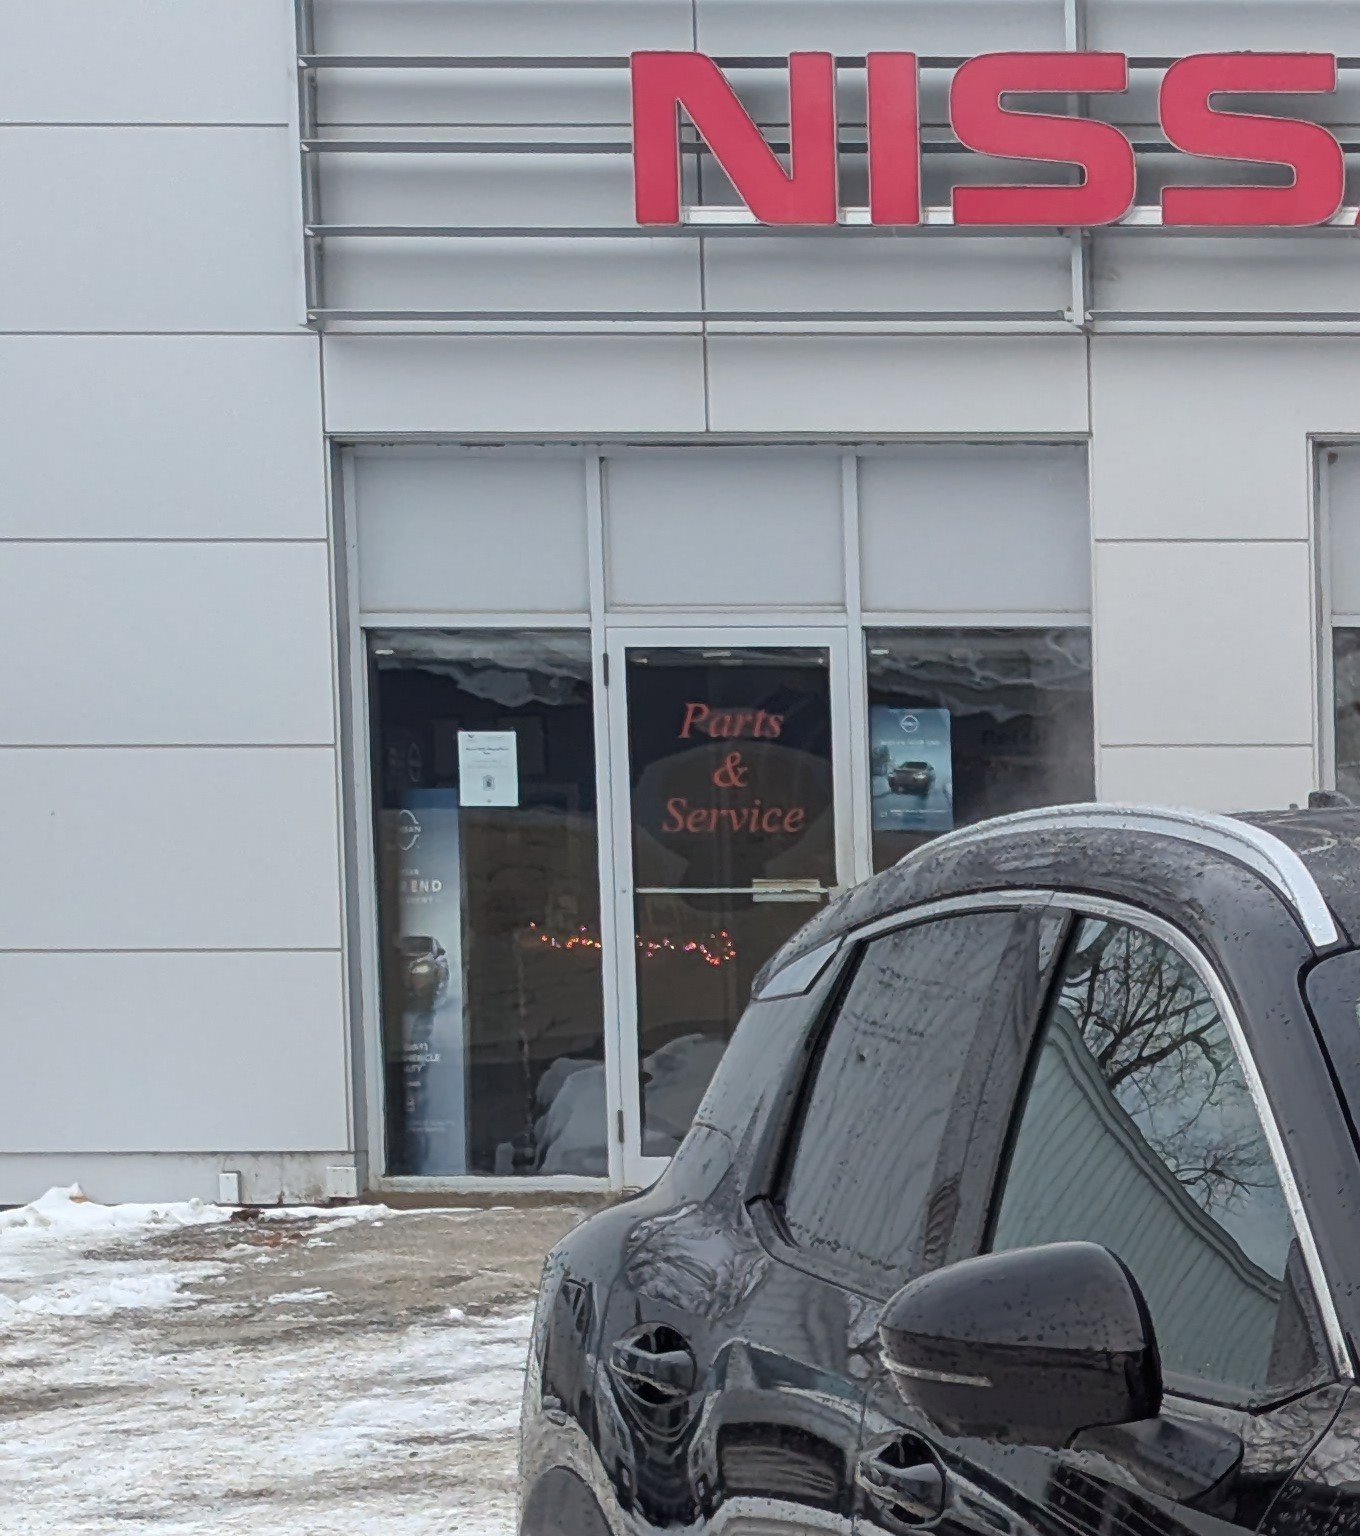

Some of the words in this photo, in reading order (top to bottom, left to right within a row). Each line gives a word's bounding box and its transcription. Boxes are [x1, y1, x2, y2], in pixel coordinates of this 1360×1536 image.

[678, 701, 784, 739] Parts
[713, 752, 748, 788] &
[661, 797, 805, 834] Service
